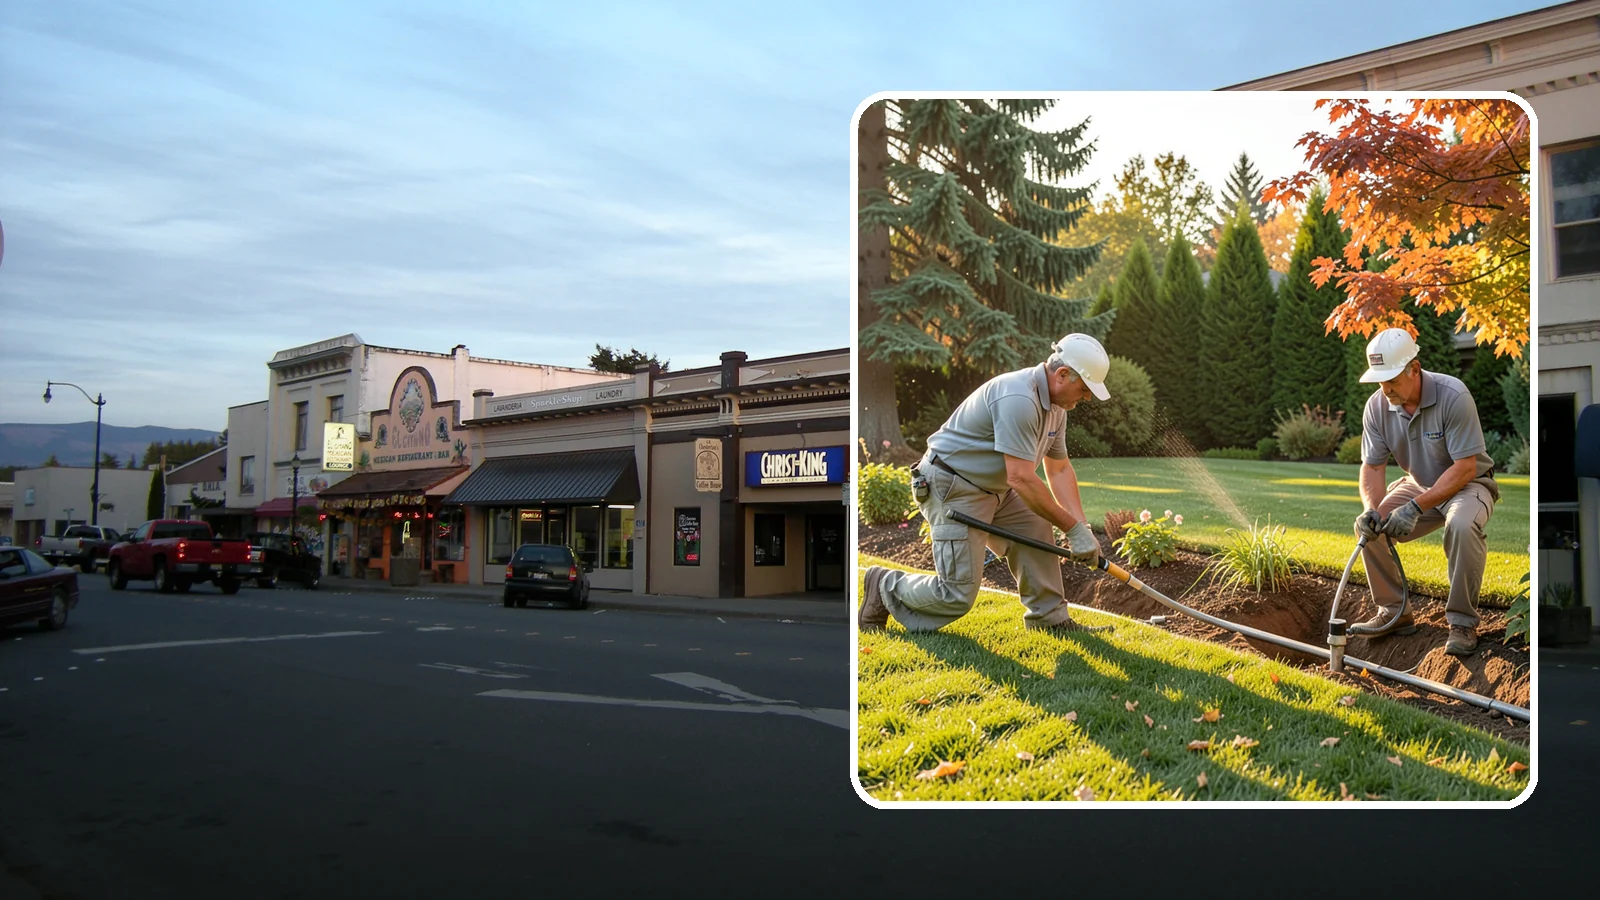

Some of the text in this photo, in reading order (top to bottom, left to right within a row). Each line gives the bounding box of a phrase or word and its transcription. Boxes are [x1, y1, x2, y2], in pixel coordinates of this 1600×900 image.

[595, 389, 624, 400] LAUNDRY
[493, 403, 523, 413] LAVANDERIA
[530, 395, 582, 409] Sparkle Shop
[373, 455, 396, 464] MEXICAN
[397, 451, 433, 462] RESTAURANT
[438, 450, 450, 458] BAR
[761, 450, 827, 478] CHRIST KING
